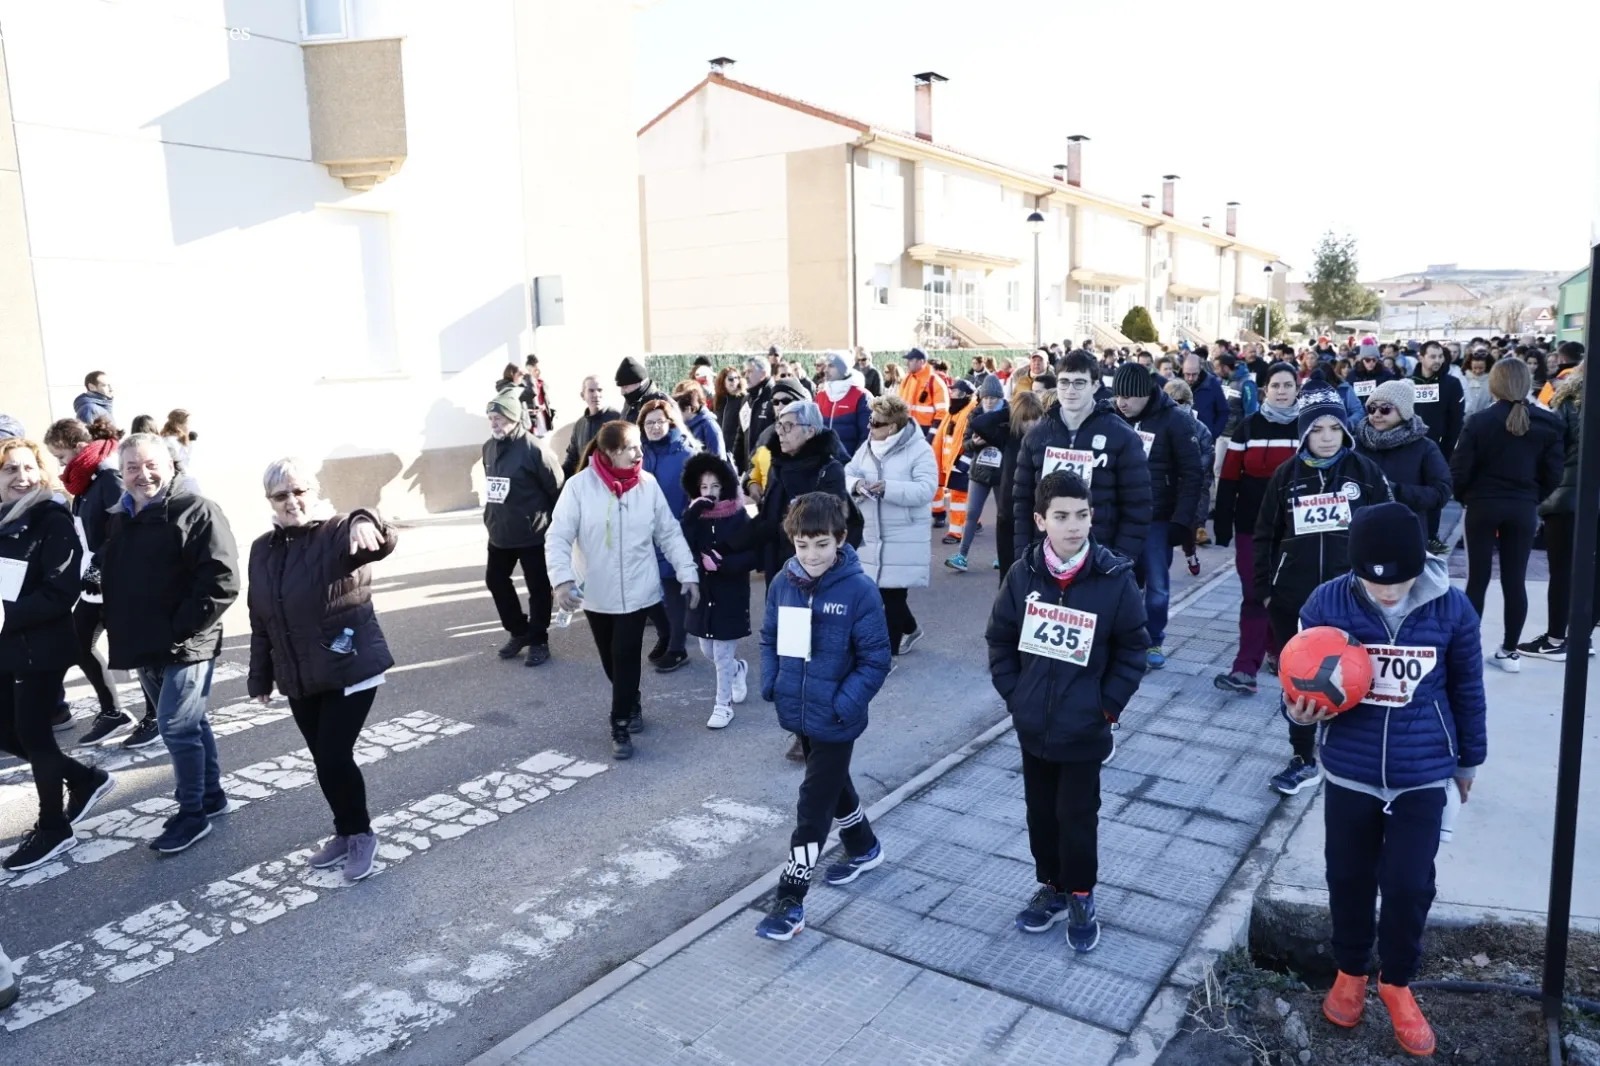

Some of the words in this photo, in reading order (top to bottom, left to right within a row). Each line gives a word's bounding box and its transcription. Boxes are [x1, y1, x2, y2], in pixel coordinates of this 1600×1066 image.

[1415, 391, 1433, 399] 389
[1047, 448, 1093, 462] bedunia
[491, 483, 506, 491] 974
[1304, 506, 1340, 524] 434
[1028, 603, 1094, 628] bedunia
[1034, 622, 1081, 649] 435
[1378, 657, 1421, 681] 700
